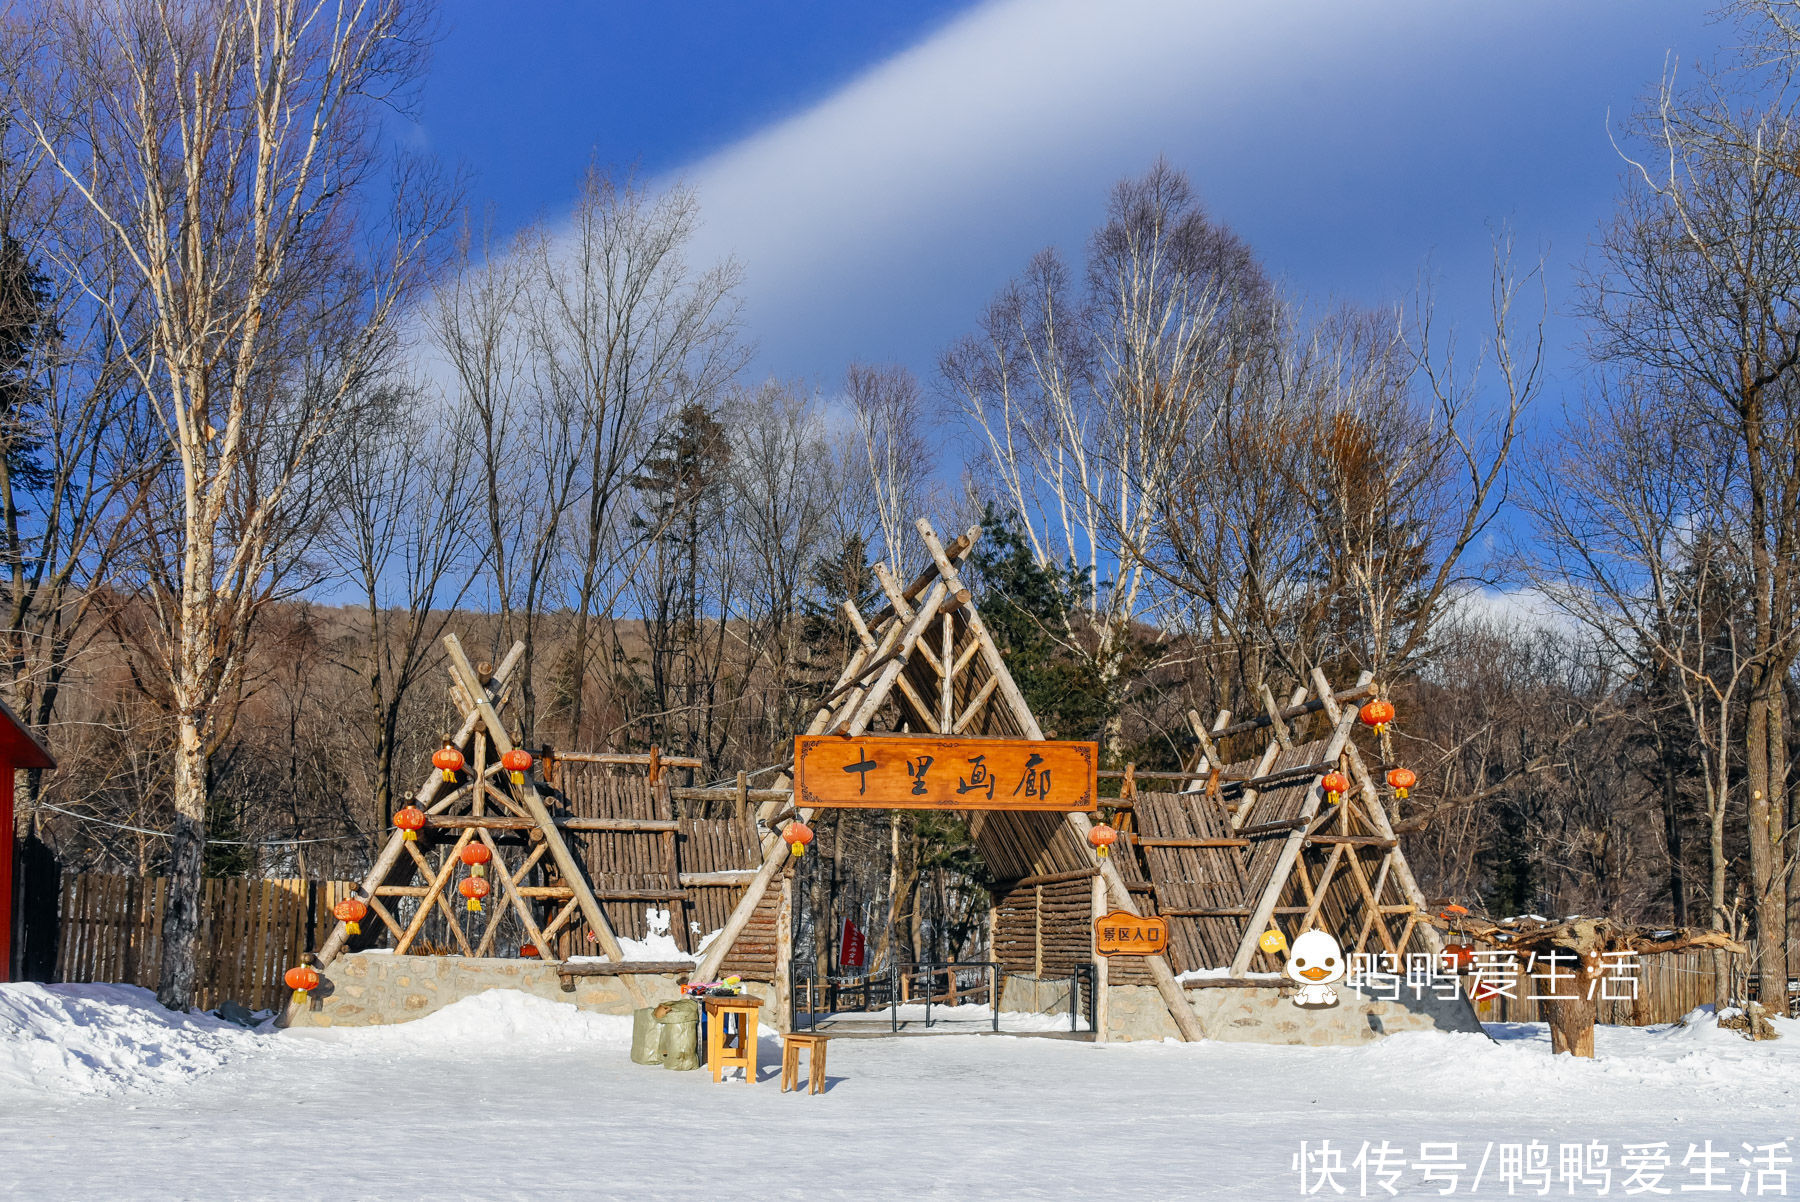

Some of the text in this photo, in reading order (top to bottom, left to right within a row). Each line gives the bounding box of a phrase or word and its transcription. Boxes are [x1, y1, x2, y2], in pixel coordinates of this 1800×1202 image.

[842, 746, 1051, 801] 十里画廊
[1103, 927, 1159, 942] 景区入口
